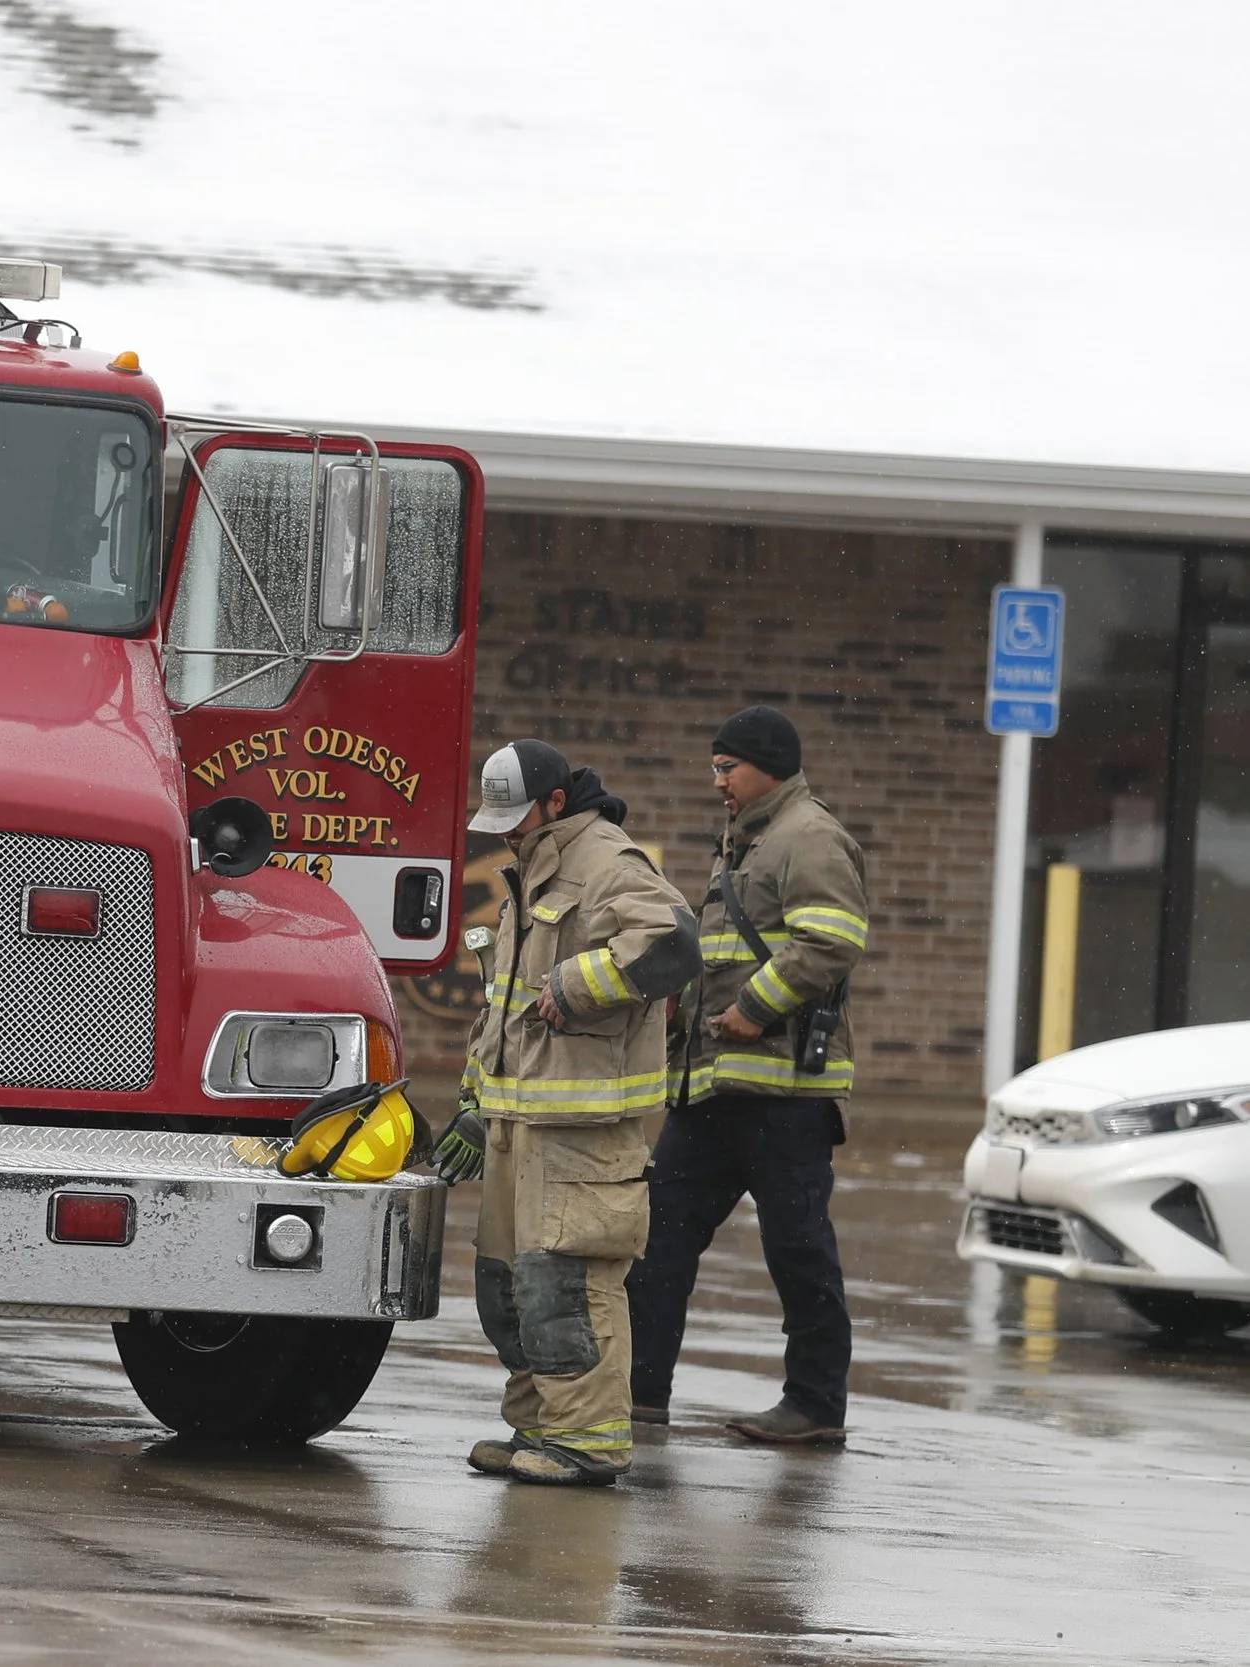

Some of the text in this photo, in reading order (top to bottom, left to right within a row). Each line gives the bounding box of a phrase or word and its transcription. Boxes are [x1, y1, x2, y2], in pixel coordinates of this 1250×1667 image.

[191, 727, 289, 789] WEST
[303, 726, 421, 801] ODESSA
[266, 768, 347, 799] VOL.
[302, 814, 399, 846] DEPT.
